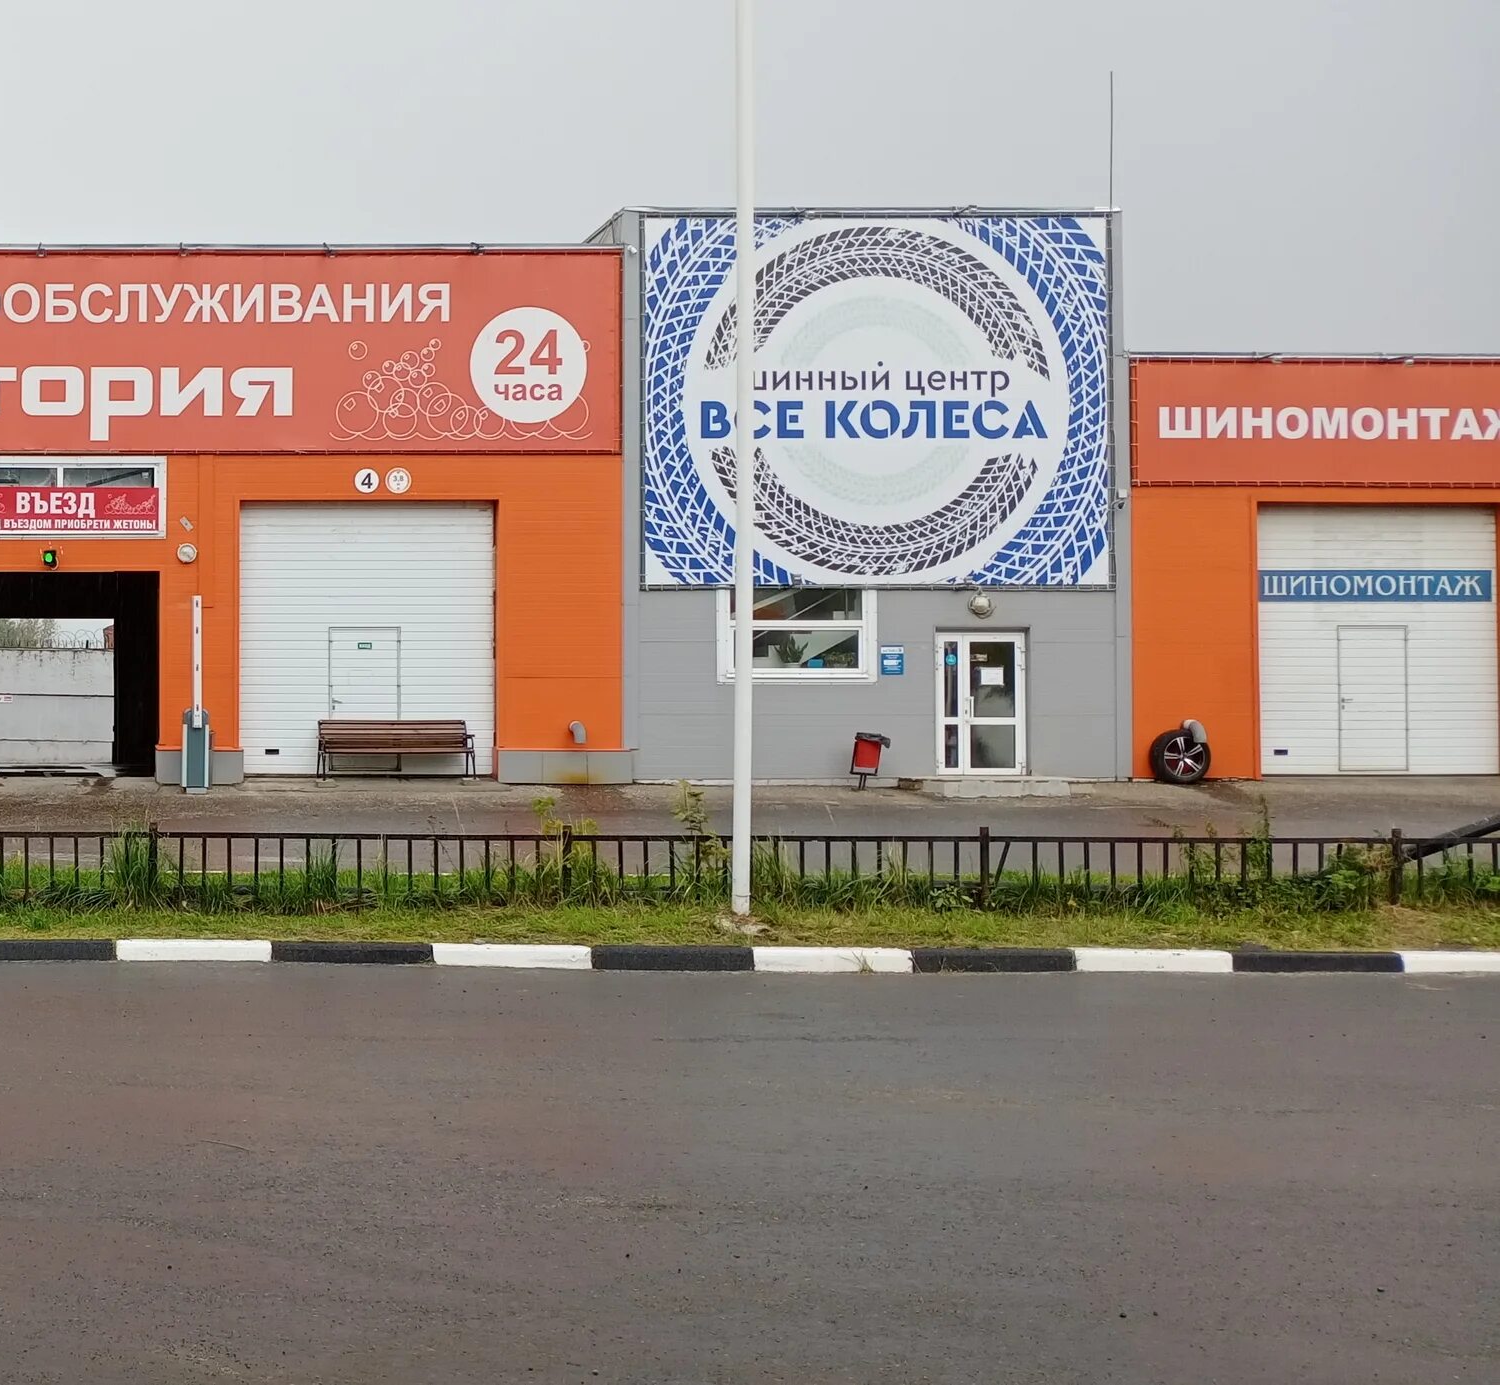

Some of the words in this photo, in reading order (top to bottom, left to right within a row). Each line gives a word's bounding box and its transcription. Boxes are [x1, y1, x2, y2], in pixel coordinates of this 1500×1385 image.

[494, 329, 563, 375] 24
[494, 383, 563, 401] часа
[905, 370, 1010, 398] центр
[700, 400, 805, 440] ВСЕ
[825, 400, 1048, 440] КОЛЕСА
[361, 472, 373, 489] 4
[16, 491, 96, 518] ВЪЕЗД
[4, 519, 52, 530] ВЪЕЗДОМ
[54, 519, 111, 530] ПРИОБРЕТИ
[112, 519, 156, 530] ЖЕТОНЫ
[1263, 575, 1483, 596] ШИНОМОНТАЖ
